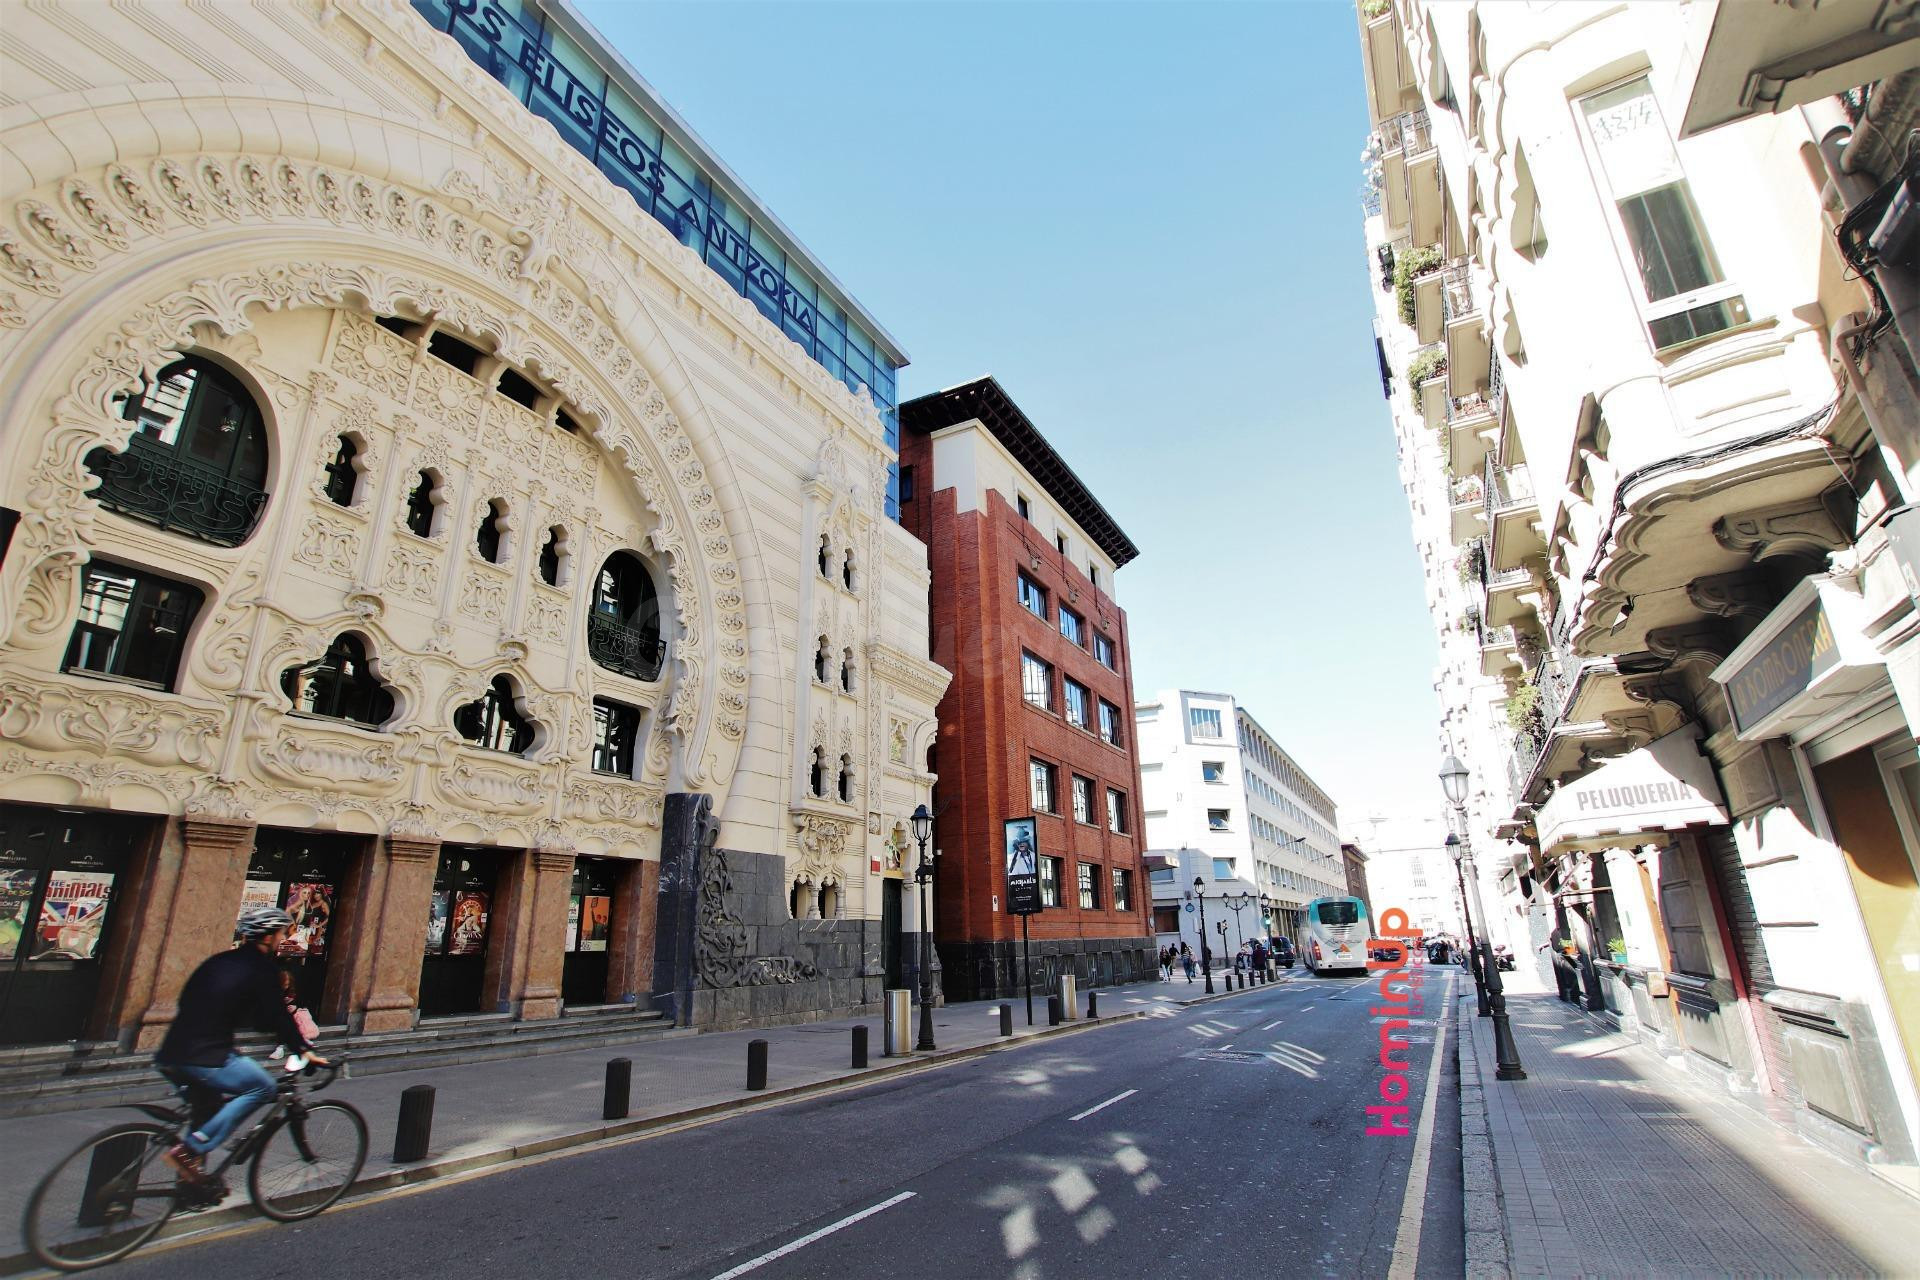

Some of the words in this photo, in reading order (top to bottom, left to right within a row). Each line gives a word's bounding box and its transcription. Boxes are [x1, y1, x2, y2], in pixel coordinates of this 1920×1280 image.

[518, 38, 666, 196] ELISEOS
[677, 198, 816, 336] ANTZOKIA
[1576, 780, 1693, 811] PELUQUERIA
